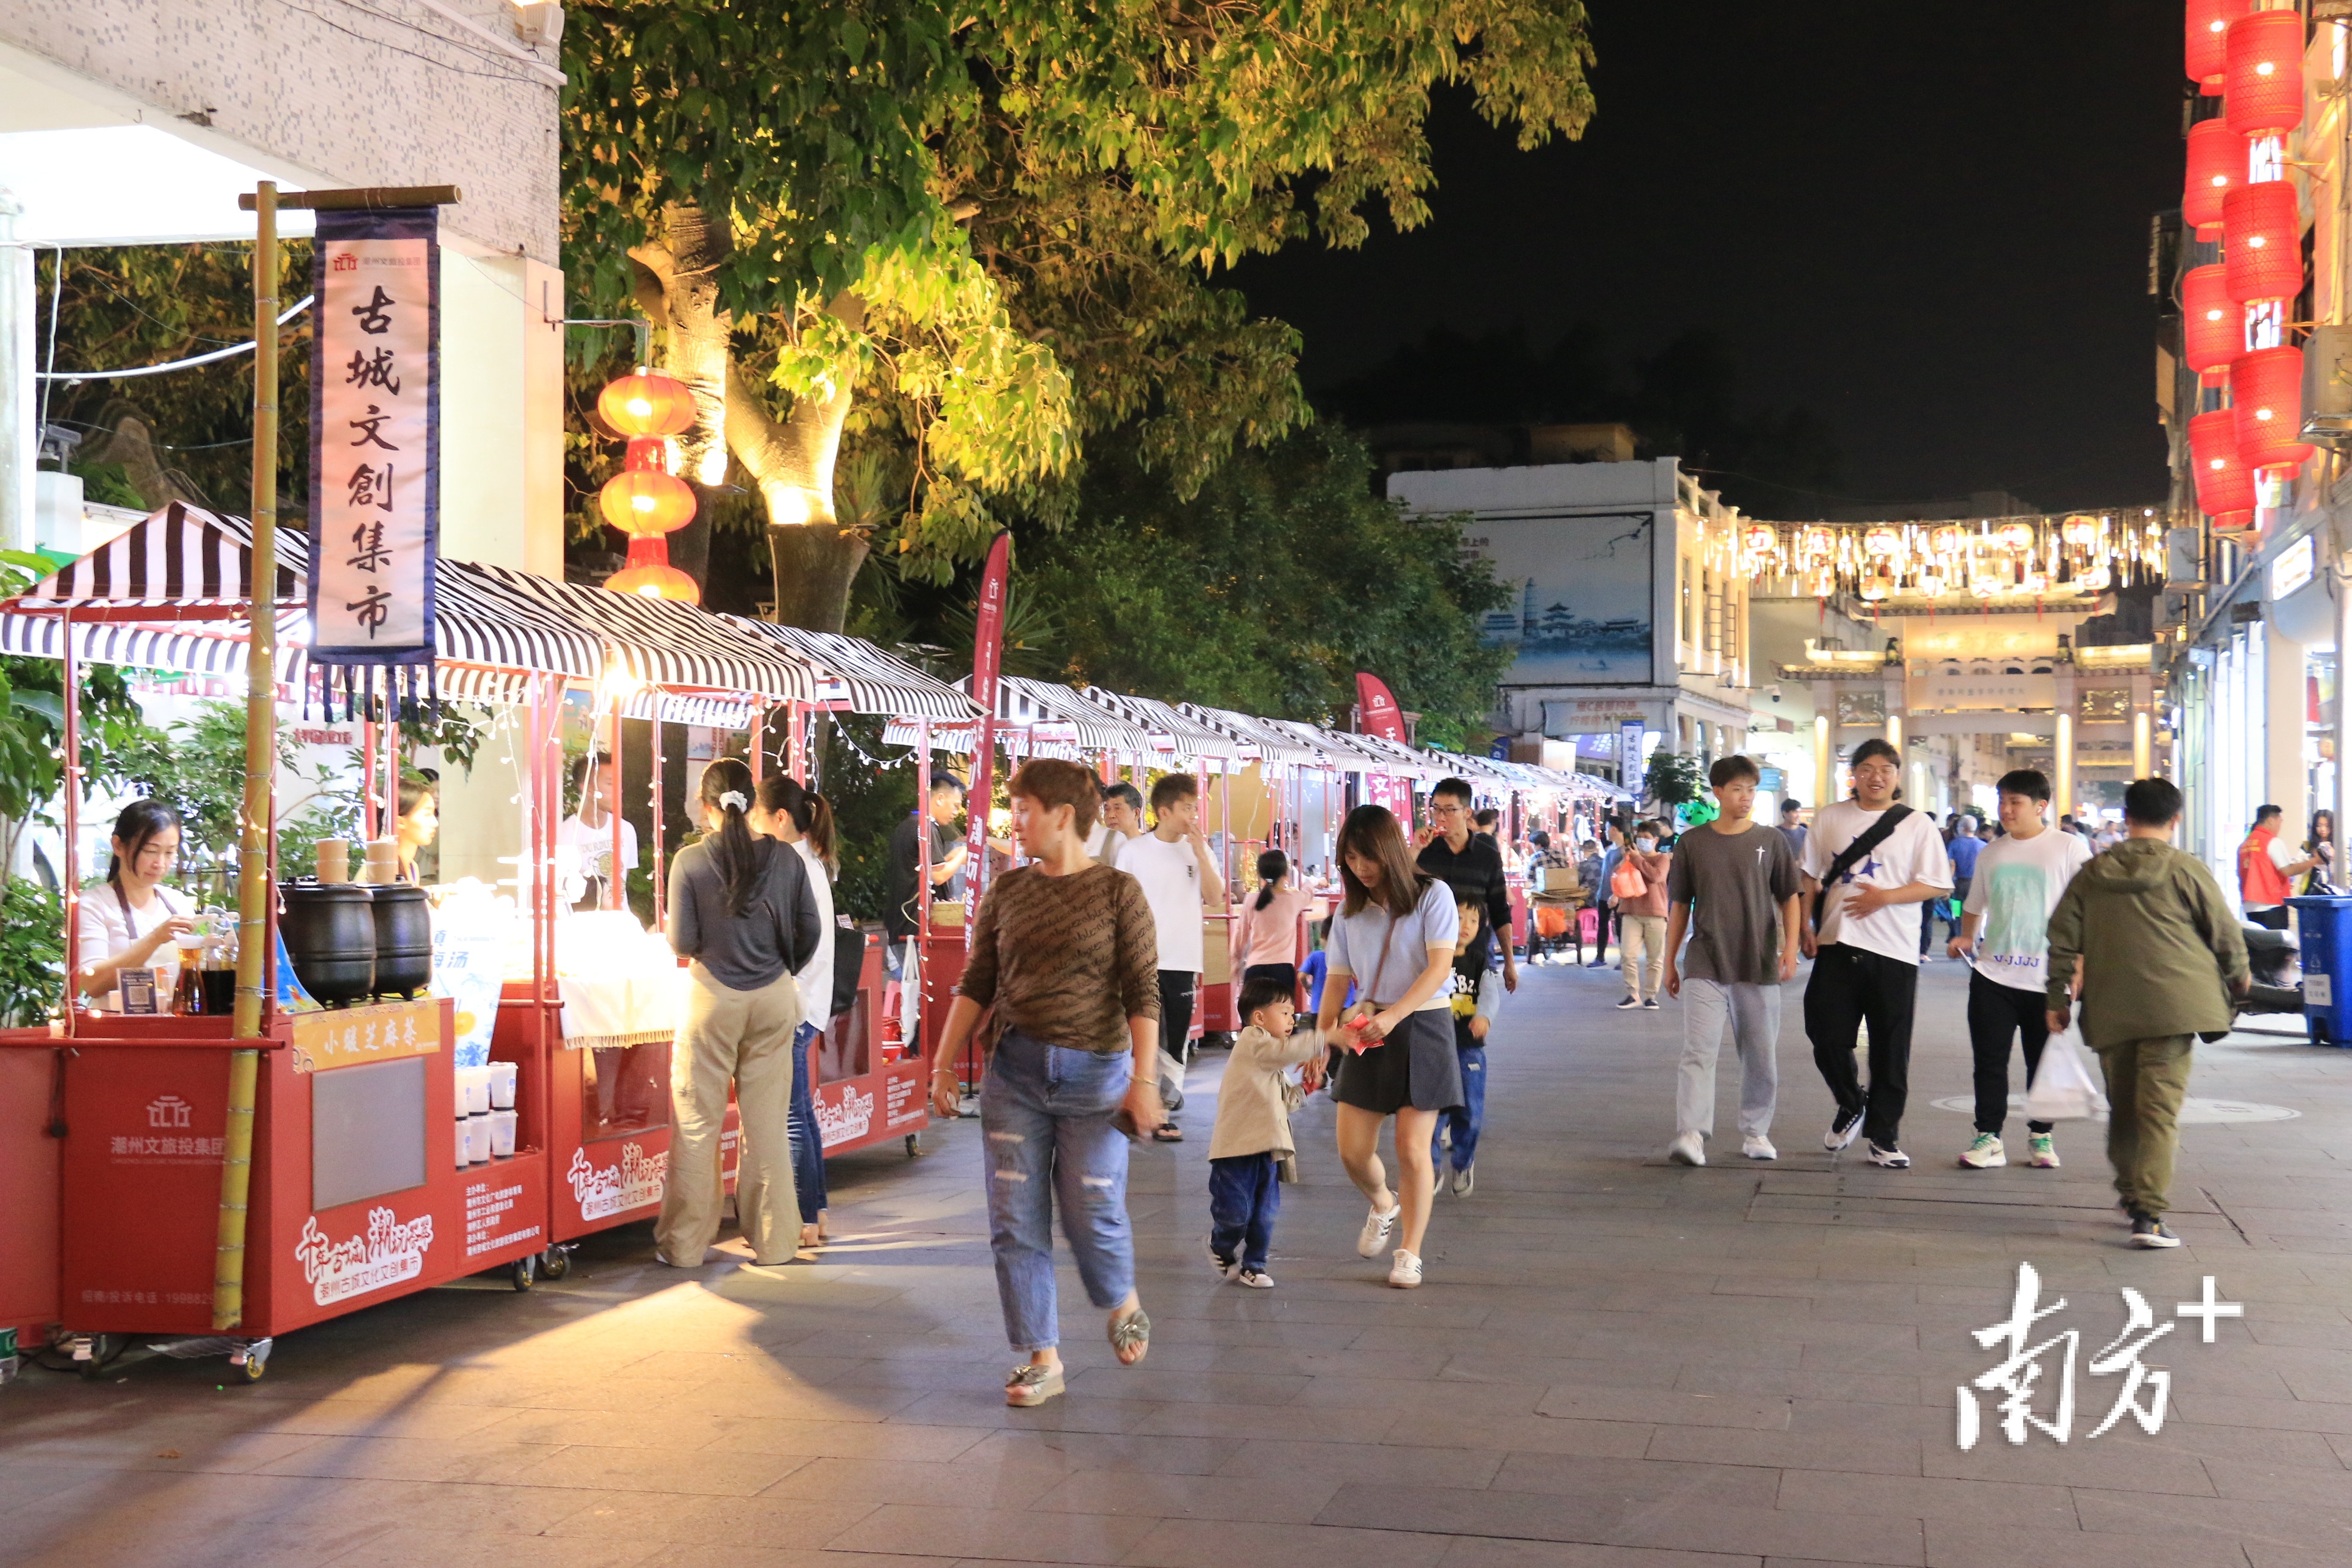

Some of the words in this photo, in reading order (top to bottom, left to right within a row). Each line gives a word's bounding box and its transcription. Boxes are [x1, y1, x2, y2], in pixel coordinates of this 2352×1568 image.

[346, 285, 400, 640] 古城文創集市
[319, 1256, 419, 1301] 潮州古城文化文创集市
